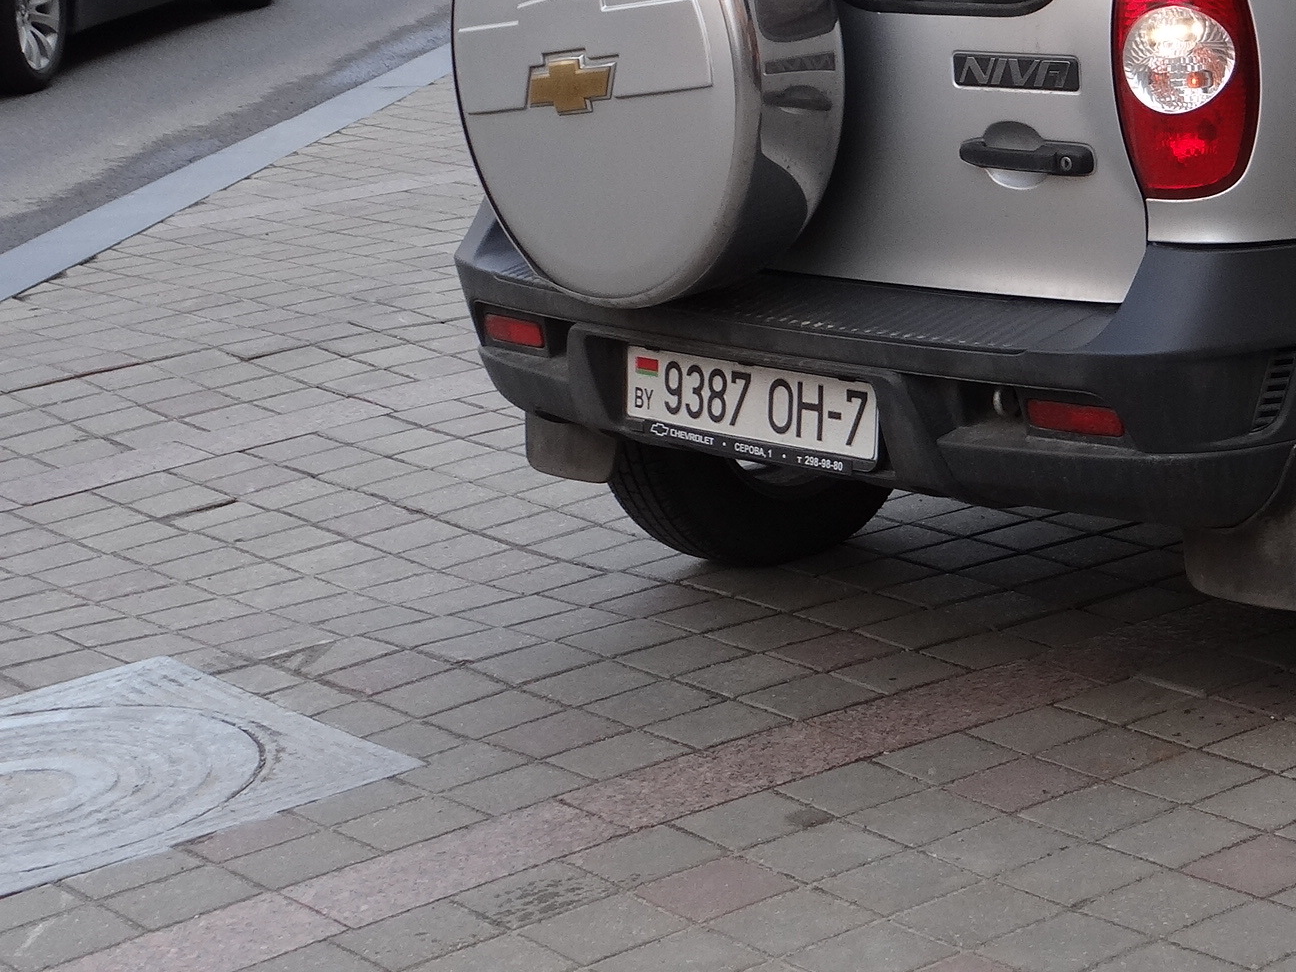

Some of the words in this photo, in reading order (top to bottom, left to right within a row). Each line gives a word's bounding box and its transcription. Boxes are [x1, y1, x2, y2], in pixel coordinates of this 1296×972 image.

[959, 56, 1071, 88] NIVA
[634, 386, 654, 409] BY
[664, 360, 752, 426] 9387
[669, 428, 714, 446] CHEVROLET
[804, 455, 843, 472] 298-98-80
